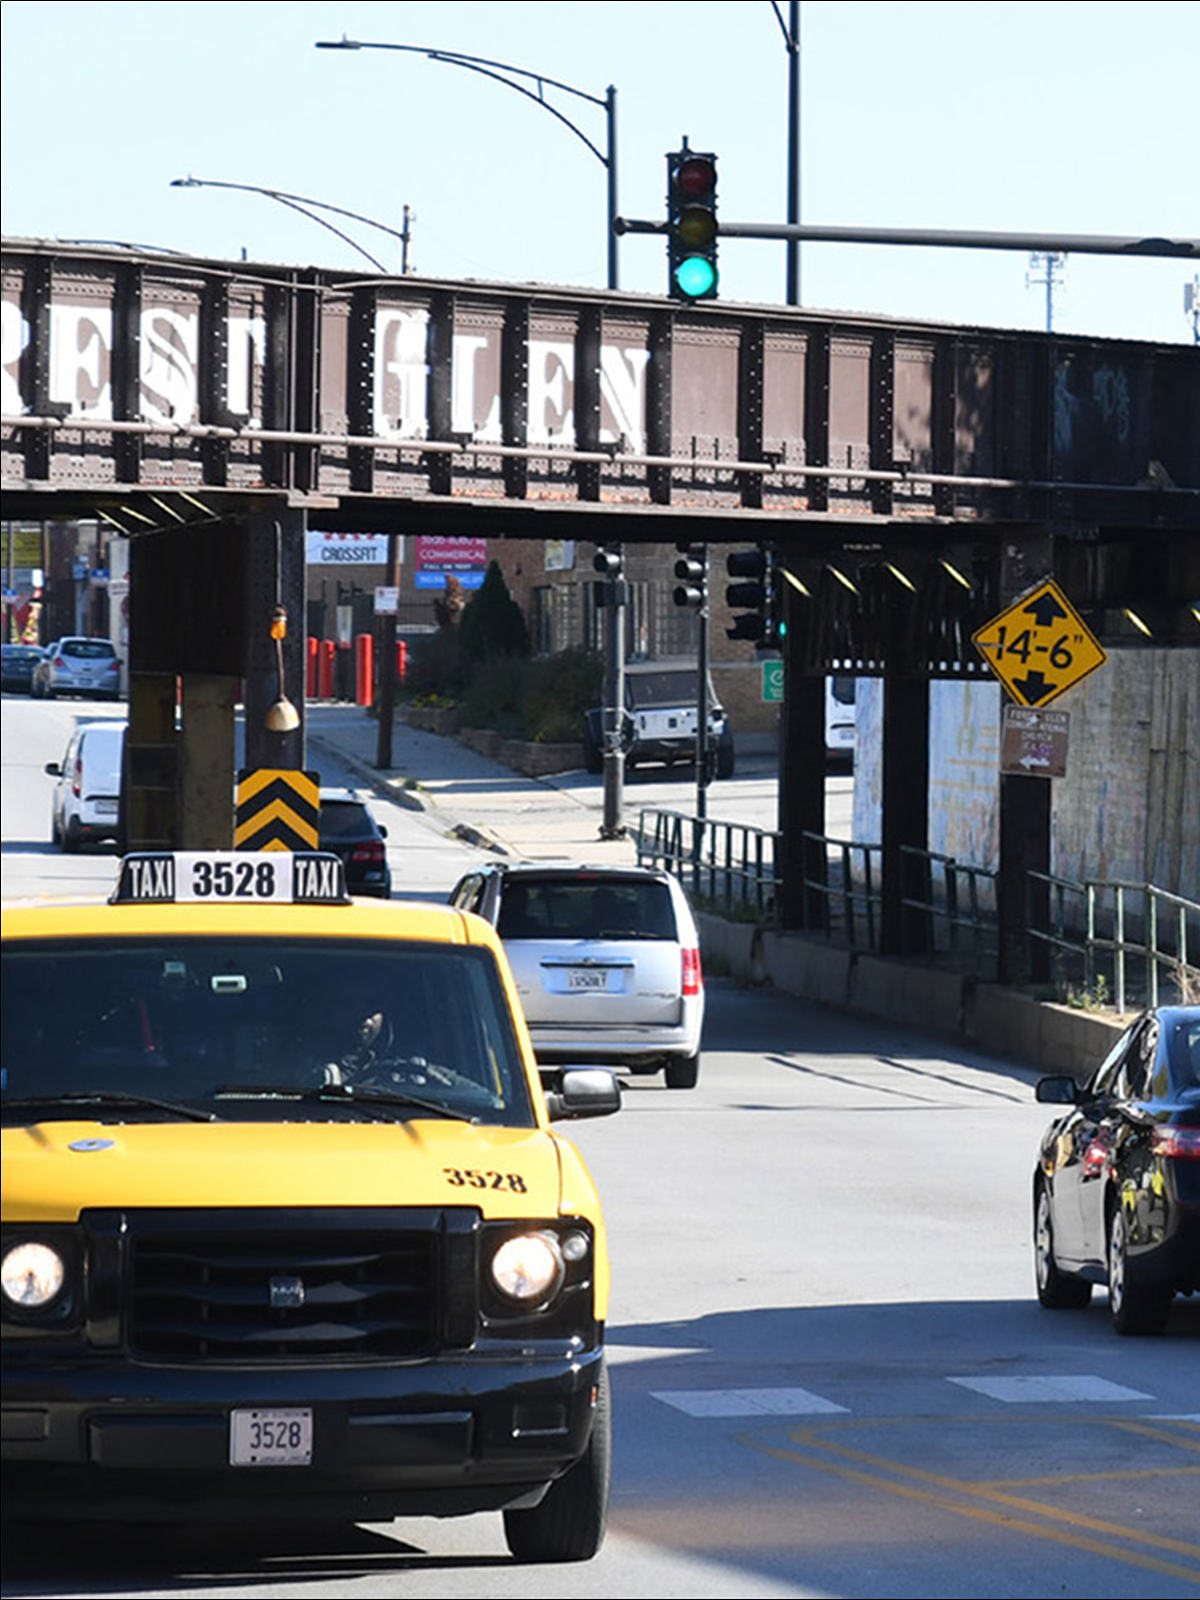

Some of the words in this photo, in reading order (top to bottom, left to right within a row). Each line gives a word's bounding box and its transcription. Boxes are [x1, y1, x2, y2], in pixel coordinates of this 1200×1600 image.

[373, 309, 650, 456] GLEN
[321, 547, 378, 561] CROSSFIT
[128, 861, 174, 898] TAXI
[192, 861, 276, 898] 3528
[296, 861, 339, 898] TAXI
[443, 1168, 528, 1194] 3528
[250, 1421, 301, 1449] 3528
